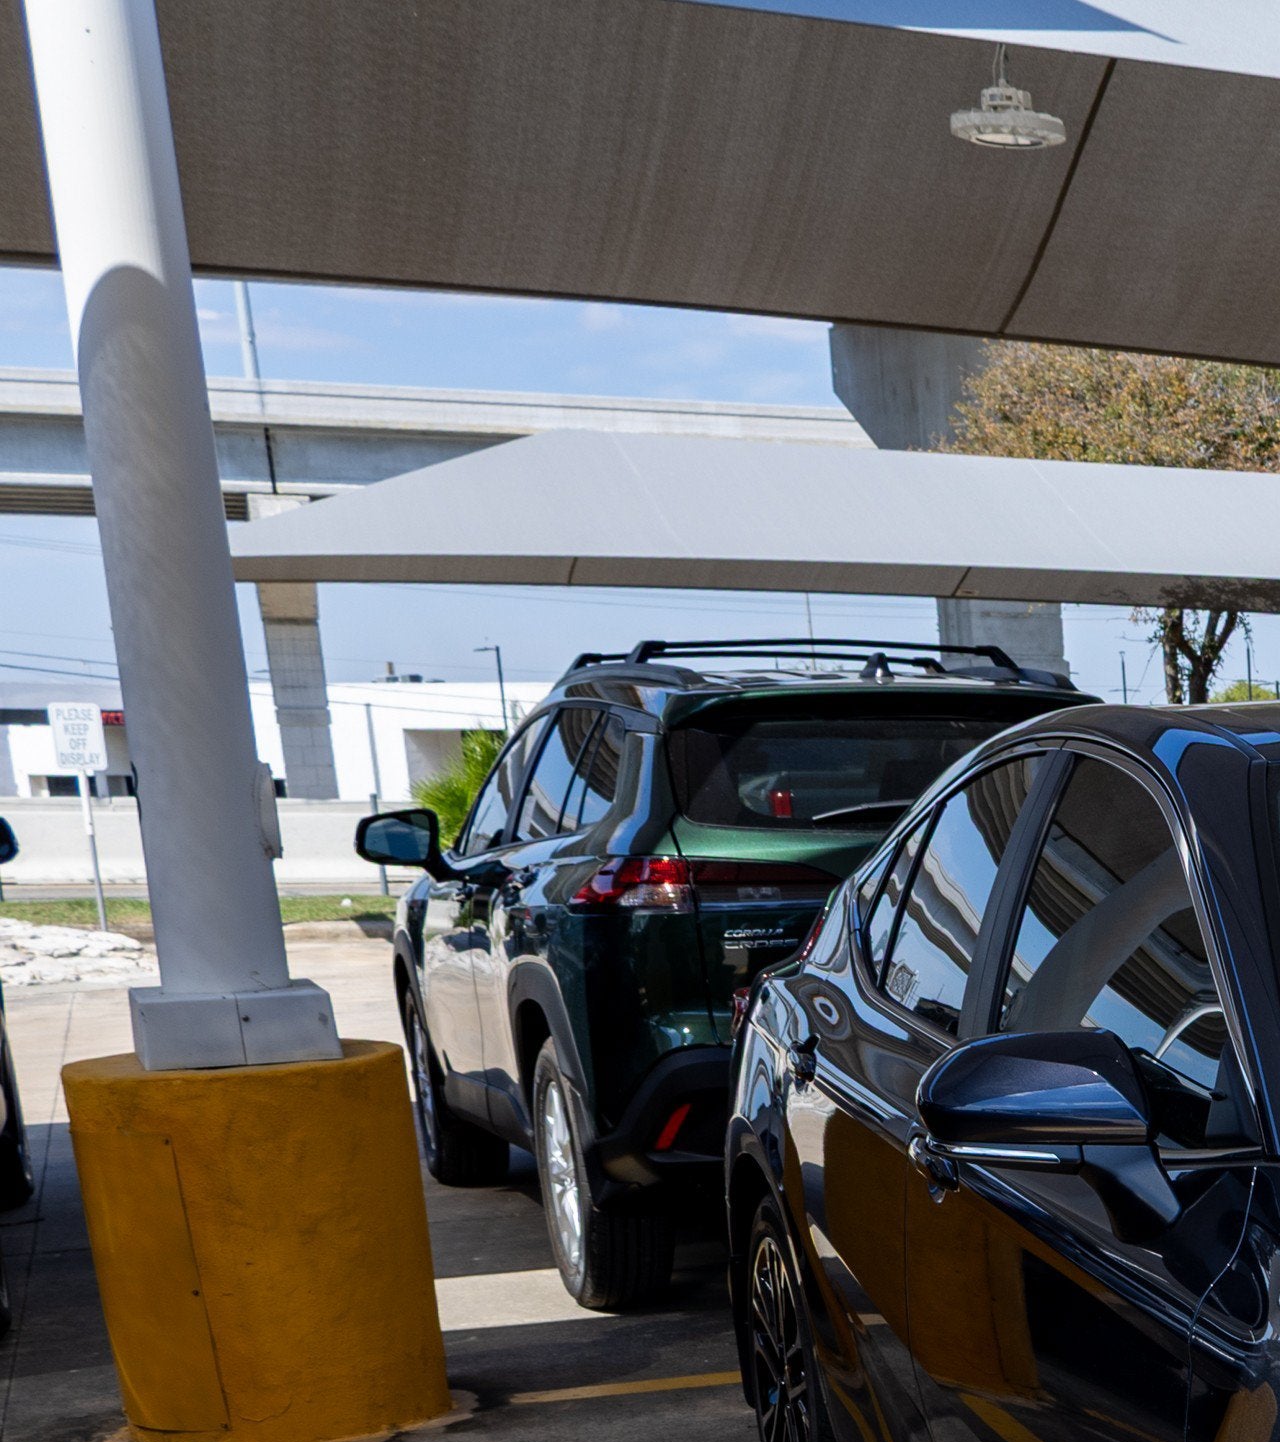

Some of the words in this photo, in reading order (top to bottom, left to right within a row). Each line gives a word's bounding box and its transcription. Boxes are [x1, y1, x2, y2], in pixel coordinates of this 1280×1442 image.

[55, 708, 93, 721] PLEASE
[63, 723, 89, 736] KEEP
[69, 737, 87, 751] OFF
[60, 751, 101, 766] DISPLAY
